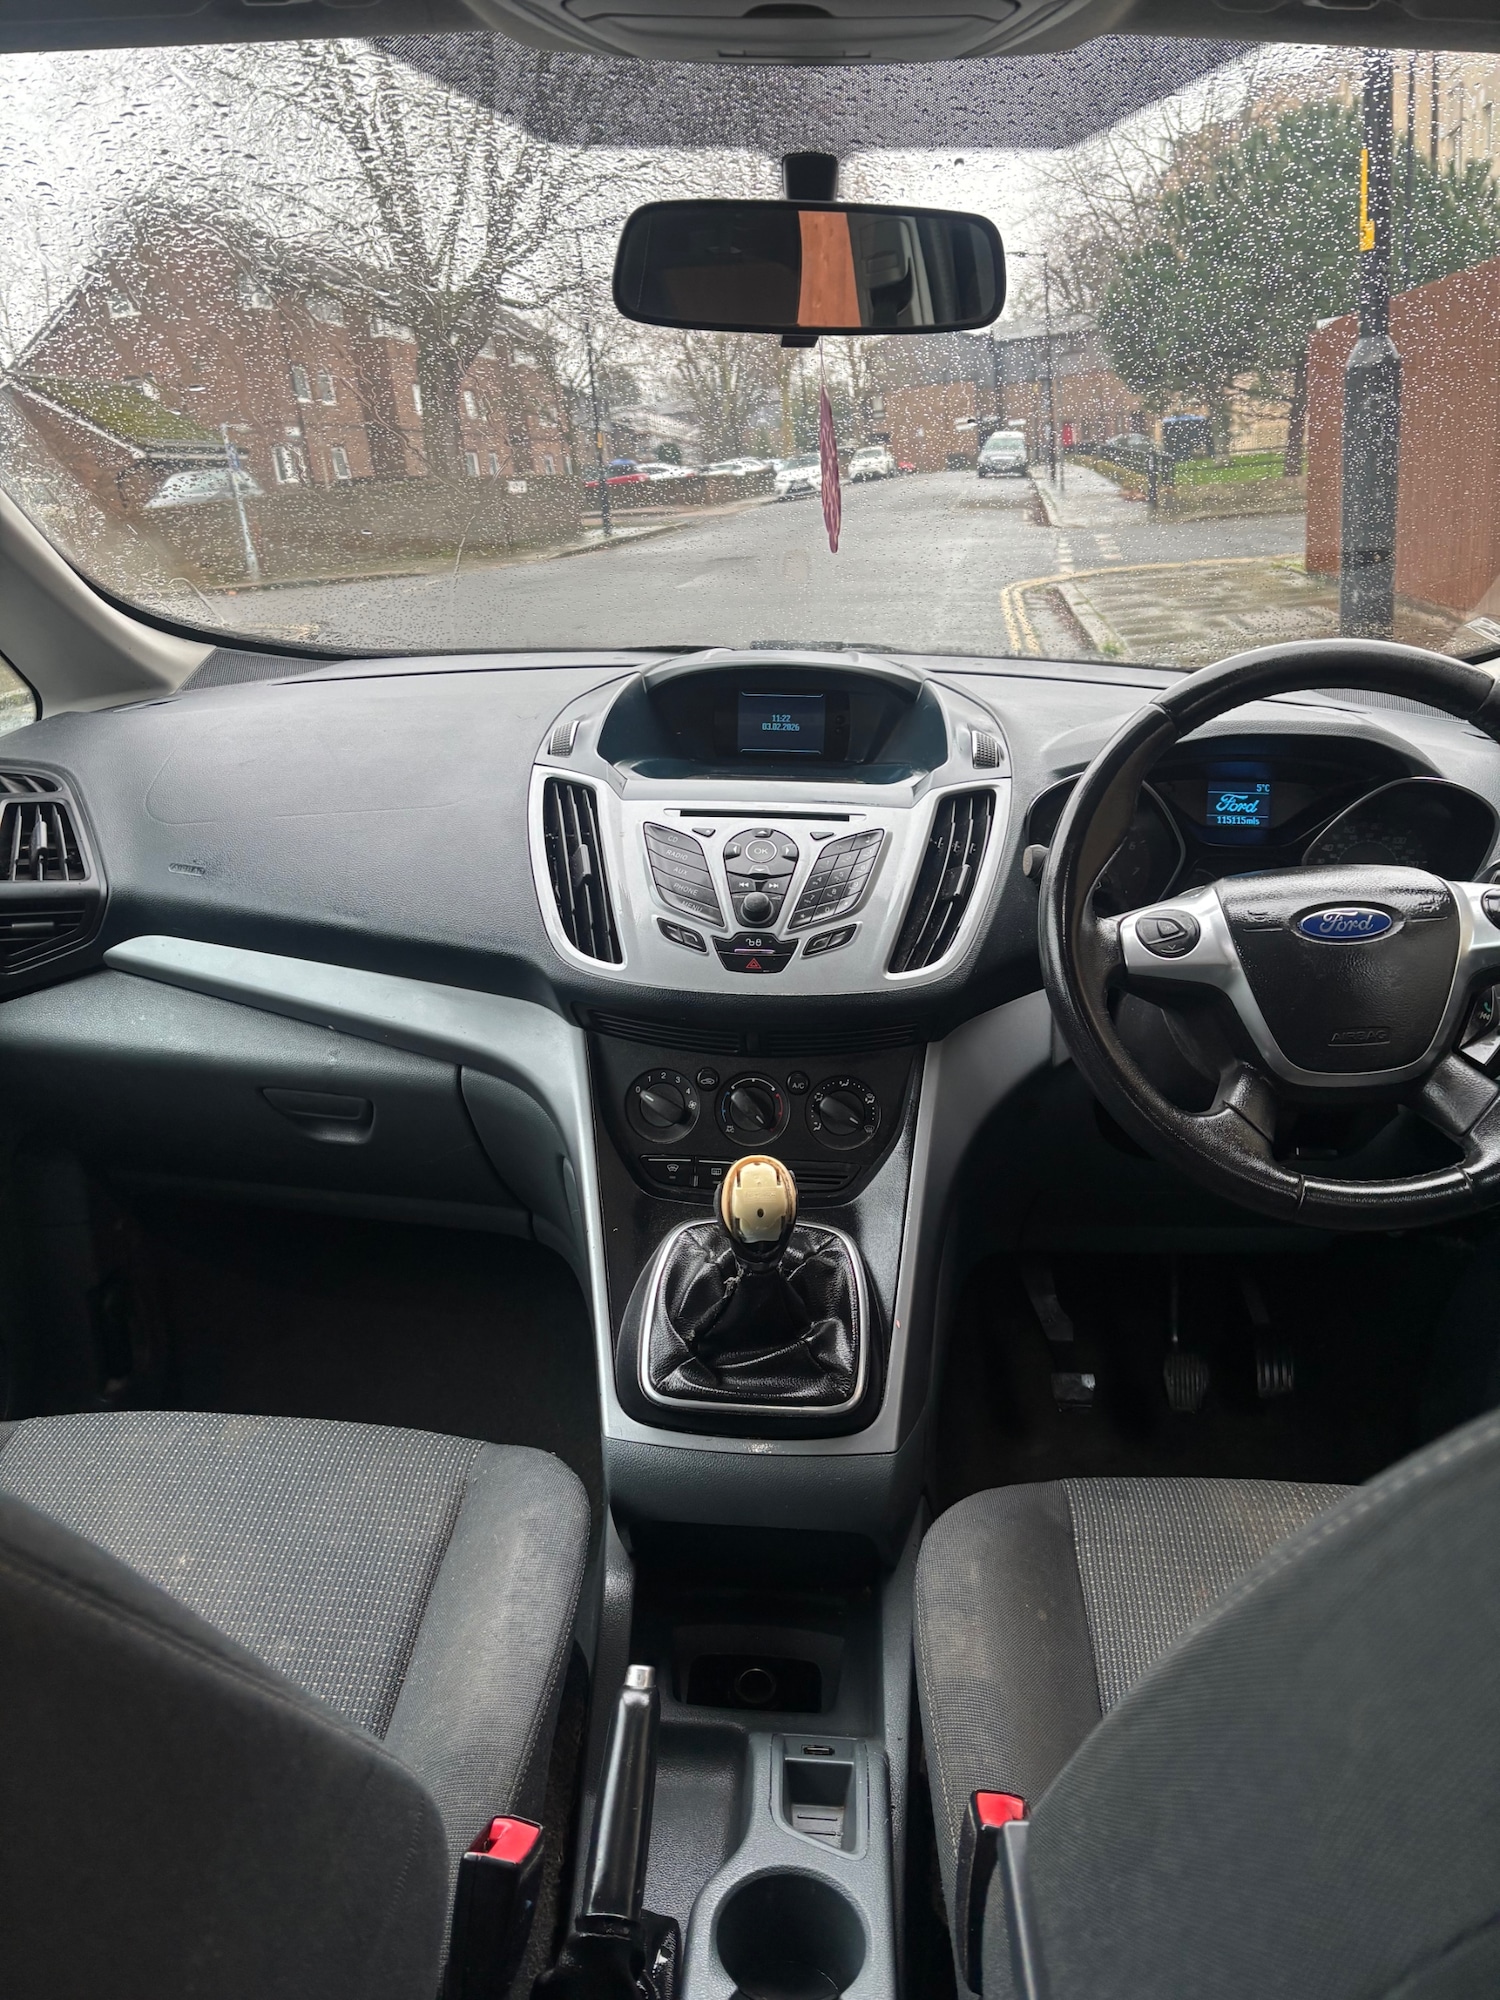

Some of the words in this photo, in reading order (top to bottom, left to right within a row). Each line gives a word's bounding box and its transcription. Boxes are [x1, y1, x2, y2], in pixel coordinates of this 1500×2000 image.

[772, 714, 791, 722] 11:22
[762, 723, 800, 731] 03.02.2026
[1216, 794, 1260, 813] Ford
[667, 835, 679, 843] CD
[666, 849, 689, 861] RADIO
[753, 847, 769, 855] OK
[672, 866, 689, 876] AUX
[673, 882, 699, 897] PHONE
[680, 900, 703, 913] MENU
[1319, 911, 1374, 933] Ford
[1331, 1029, 1387, 1042] AIRBAG
[675, 1076, 681, 1084] 3
[685, 1087, 691, 1095] 4
